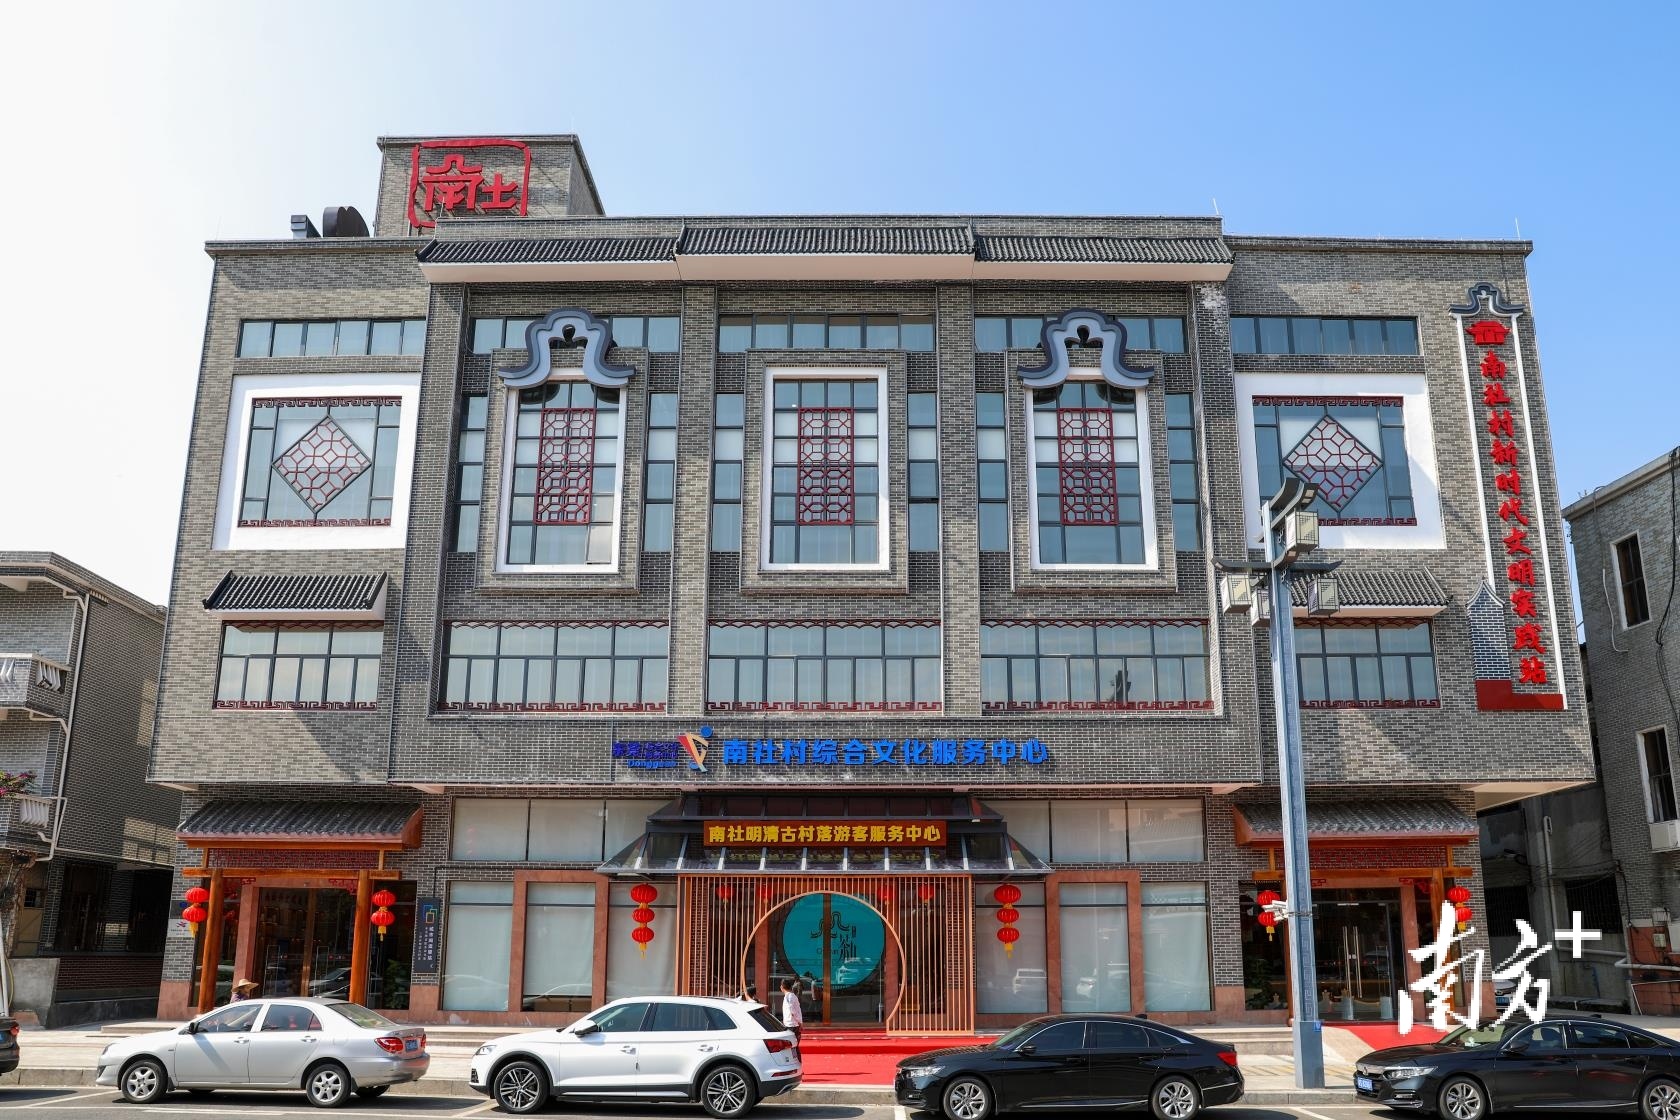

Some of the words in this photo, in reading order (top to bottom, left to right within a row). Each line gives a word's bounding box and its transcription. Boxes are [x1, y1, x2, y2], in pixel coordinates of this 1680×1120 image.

[1480, 350, 1547, 684] 南社村新时代文明实践站
[723, 739, 1048, 765] 南社村综合文化服务中心
[708, 825, 941, 843] 南社明清古村落游客服务中心
